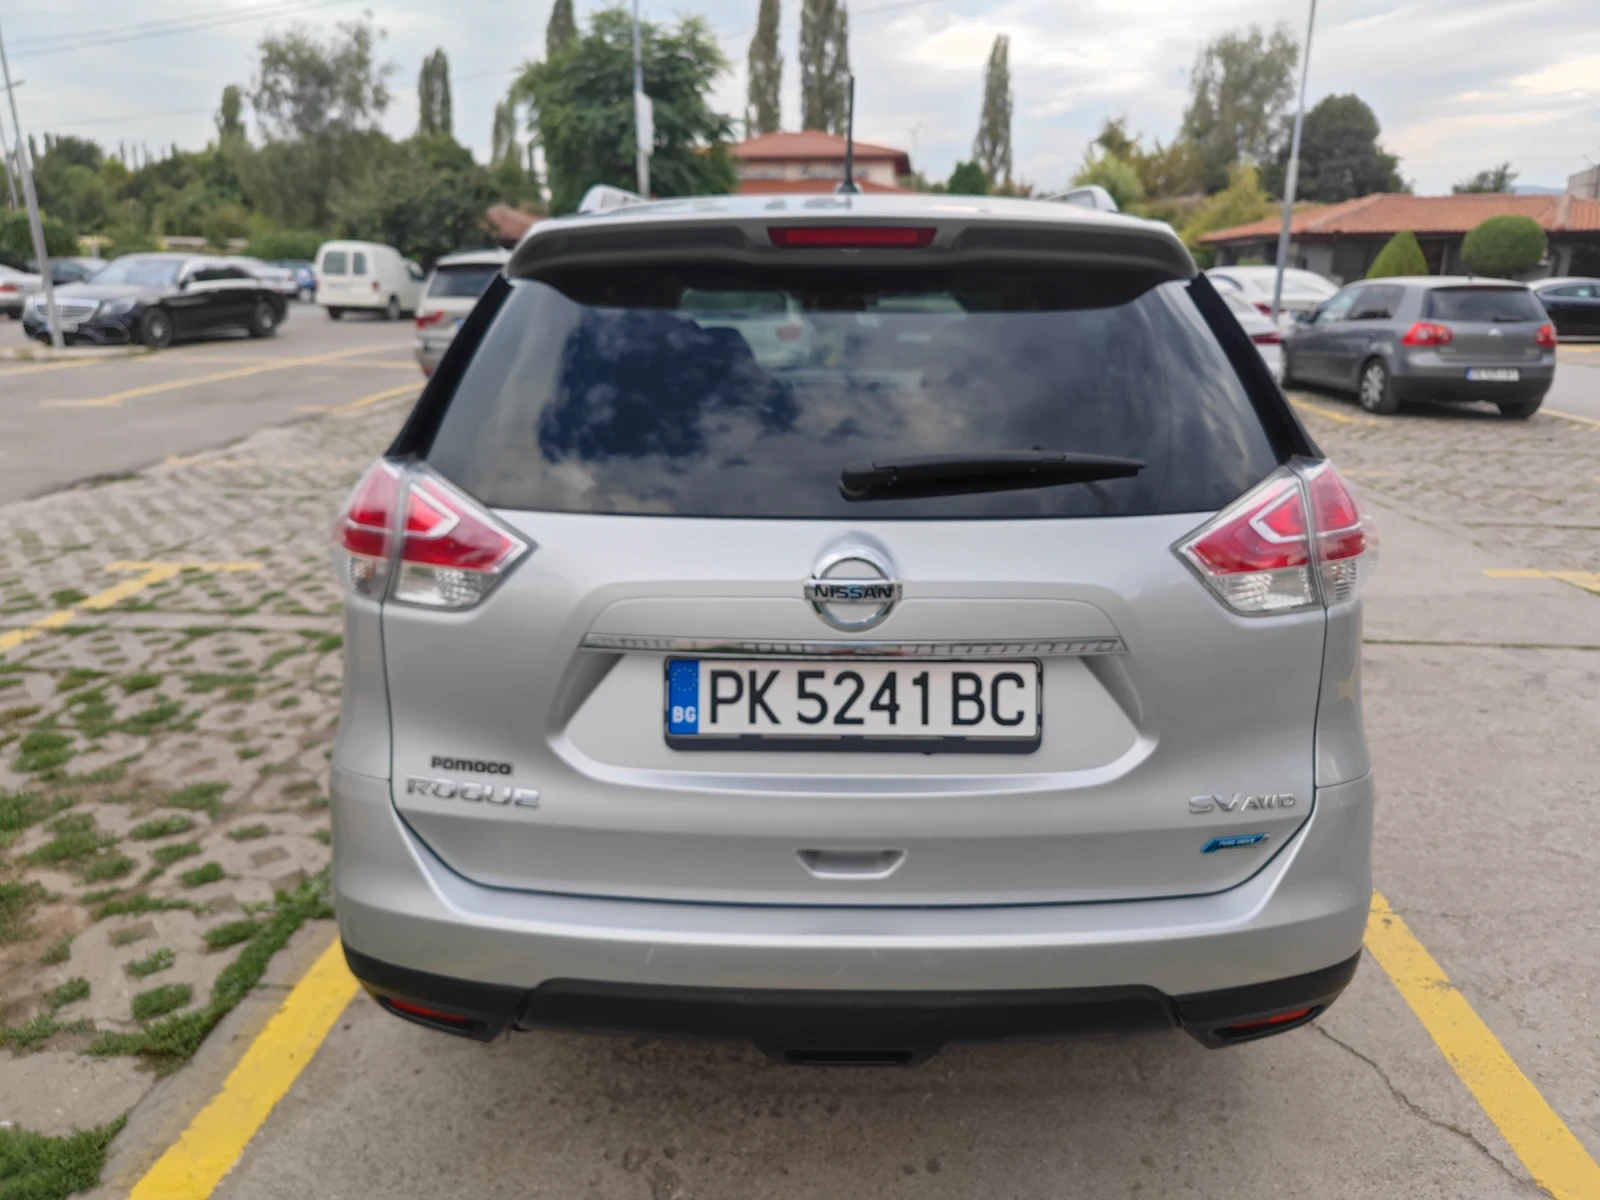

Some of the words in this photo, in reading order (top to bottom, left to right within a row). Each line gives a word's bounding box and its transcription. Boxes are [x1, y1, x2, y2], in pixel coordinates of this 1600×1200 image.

[814, 584, 893, 598] NISSAN
[672, 706, 697, 723] BG
[709, 670, 781, 725] PK
[797, 671, 930, 726] 5241
[951, 672, 1025, 727] BC
[406, 775, 539, 808] ROGUE
[1188, 793, 1241, 814] SV
[1241, 793, 1296, 811] AWD
